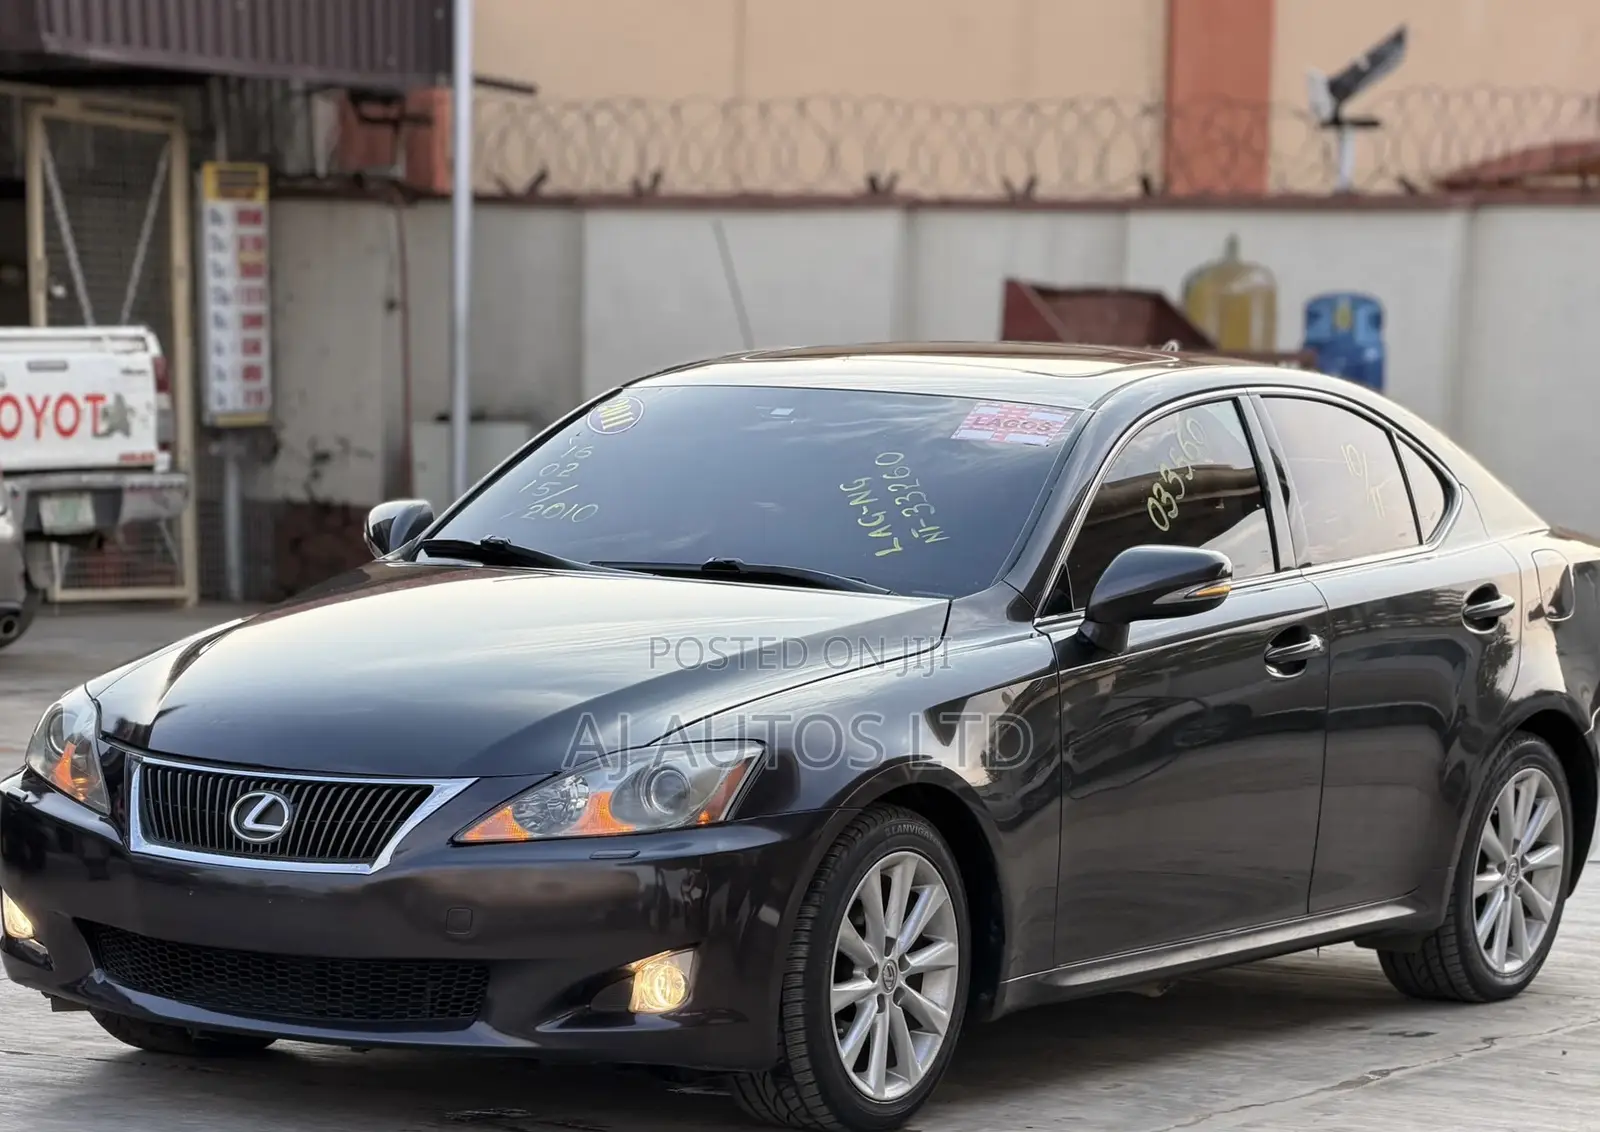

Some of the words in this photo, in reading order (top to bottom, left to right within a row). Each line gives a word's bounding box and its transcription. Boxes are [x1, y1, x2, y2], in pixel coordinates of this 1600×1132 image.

[0, 392, 131, 440] OYOT
[971, 416, 1053, 434] LAGOS
[520, 502, 599, 523] 2010
